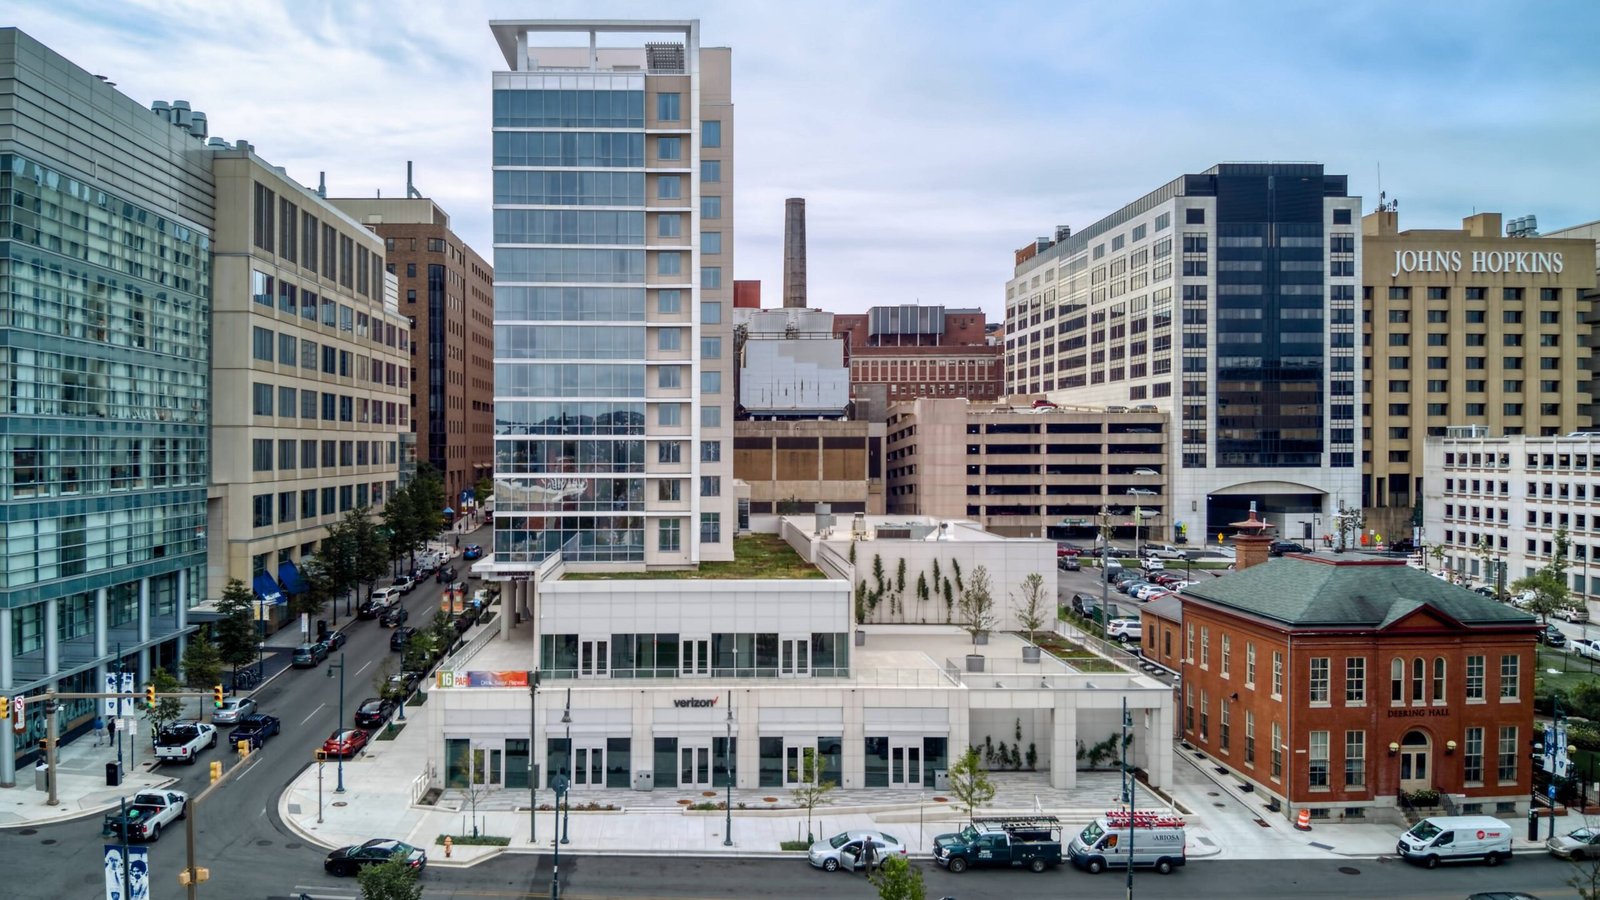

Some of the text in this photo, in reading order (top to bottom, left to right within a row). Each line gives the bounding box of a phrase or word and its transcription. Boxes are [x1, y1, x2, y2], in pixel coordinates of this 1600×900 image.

[1391, 250, 1563, 277] JOHNS HOPKINS
[442, 672, 452, 686] 16
[673, 697, 714, 707] verizon
[1387, 708, 1450, 718] DEERING HALL
